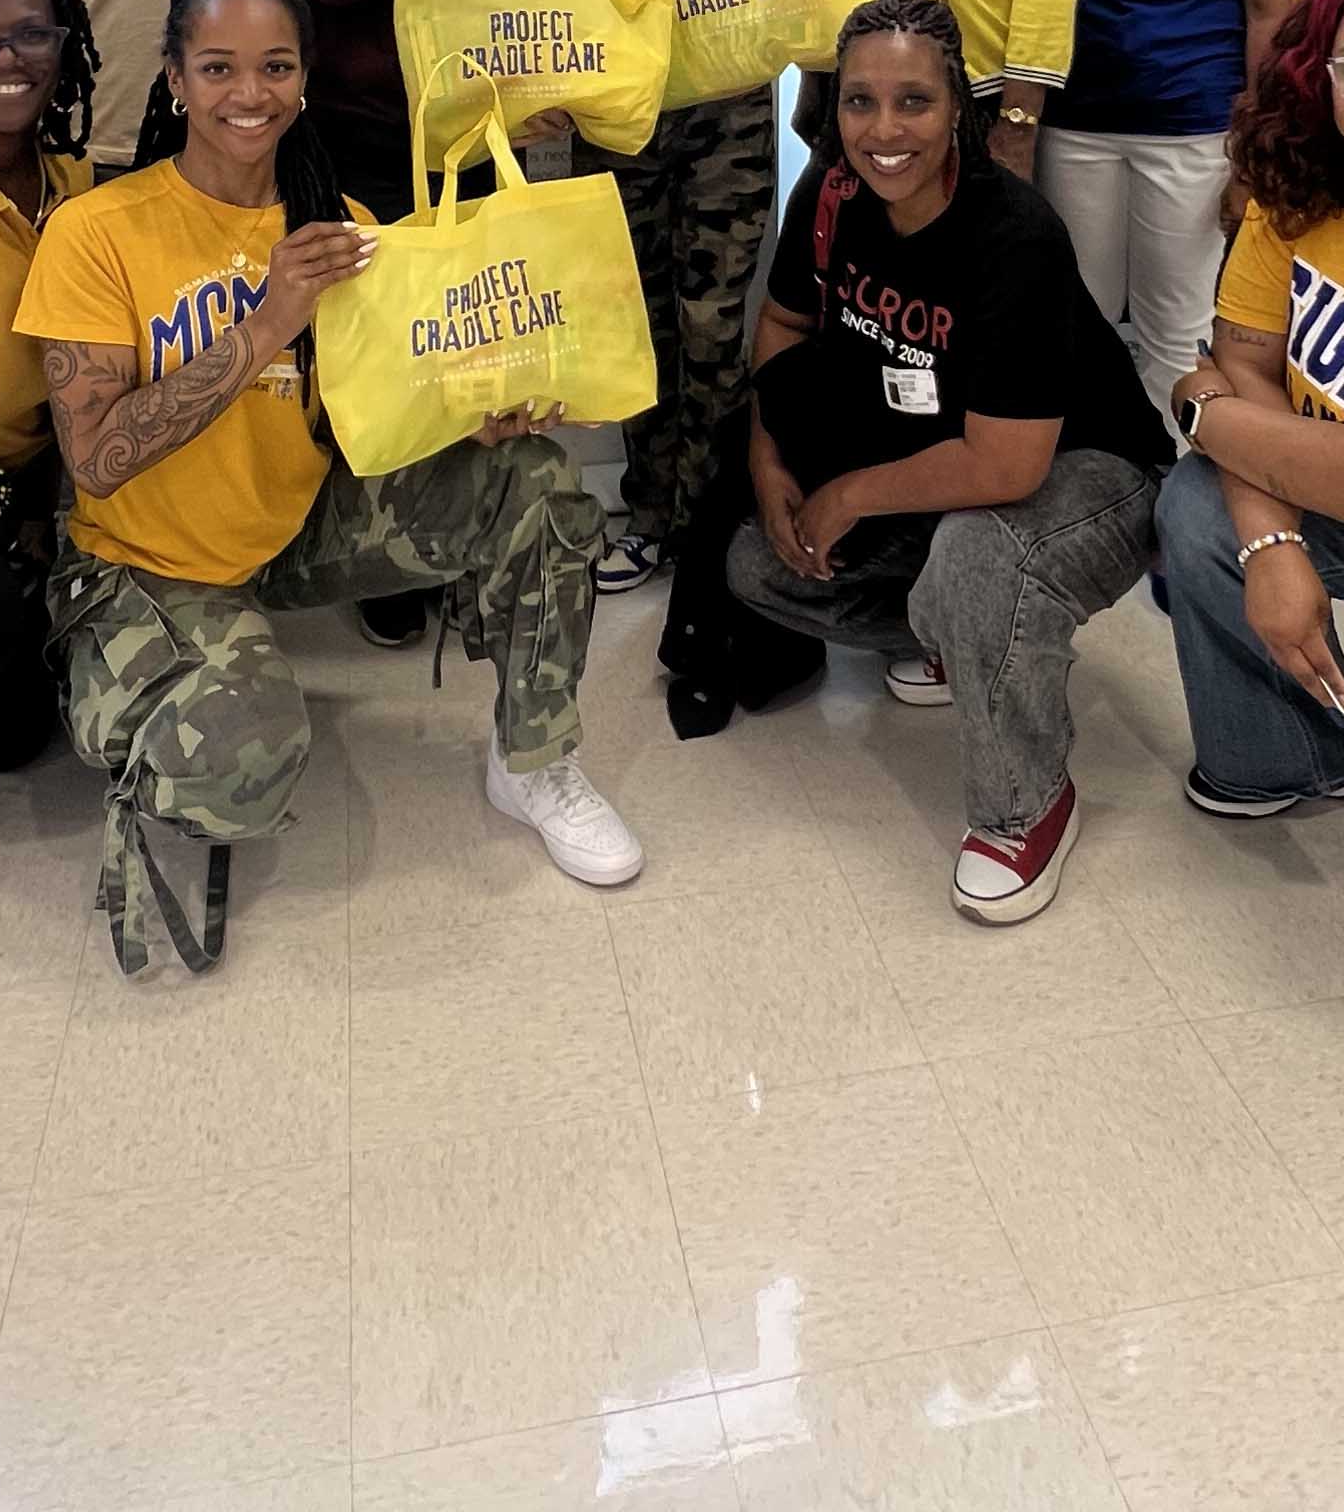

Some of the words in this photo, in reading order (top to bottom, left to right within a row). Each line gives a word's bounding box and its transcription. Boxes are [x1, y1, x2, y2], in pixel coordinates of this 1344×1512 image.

[490, 10, 574, 43] PROJECT
[461, 43, 544, 81] CRADLE
[552, 42, 606, 74] CARE
[445, 259, 532, 318] PROJECT
[411, 303, 504, 358] CRADLE
[510, 290, 568, 338] CARE
[840, 306, 881, 340] SINCE
[897, 343, 936, 369] 2009
